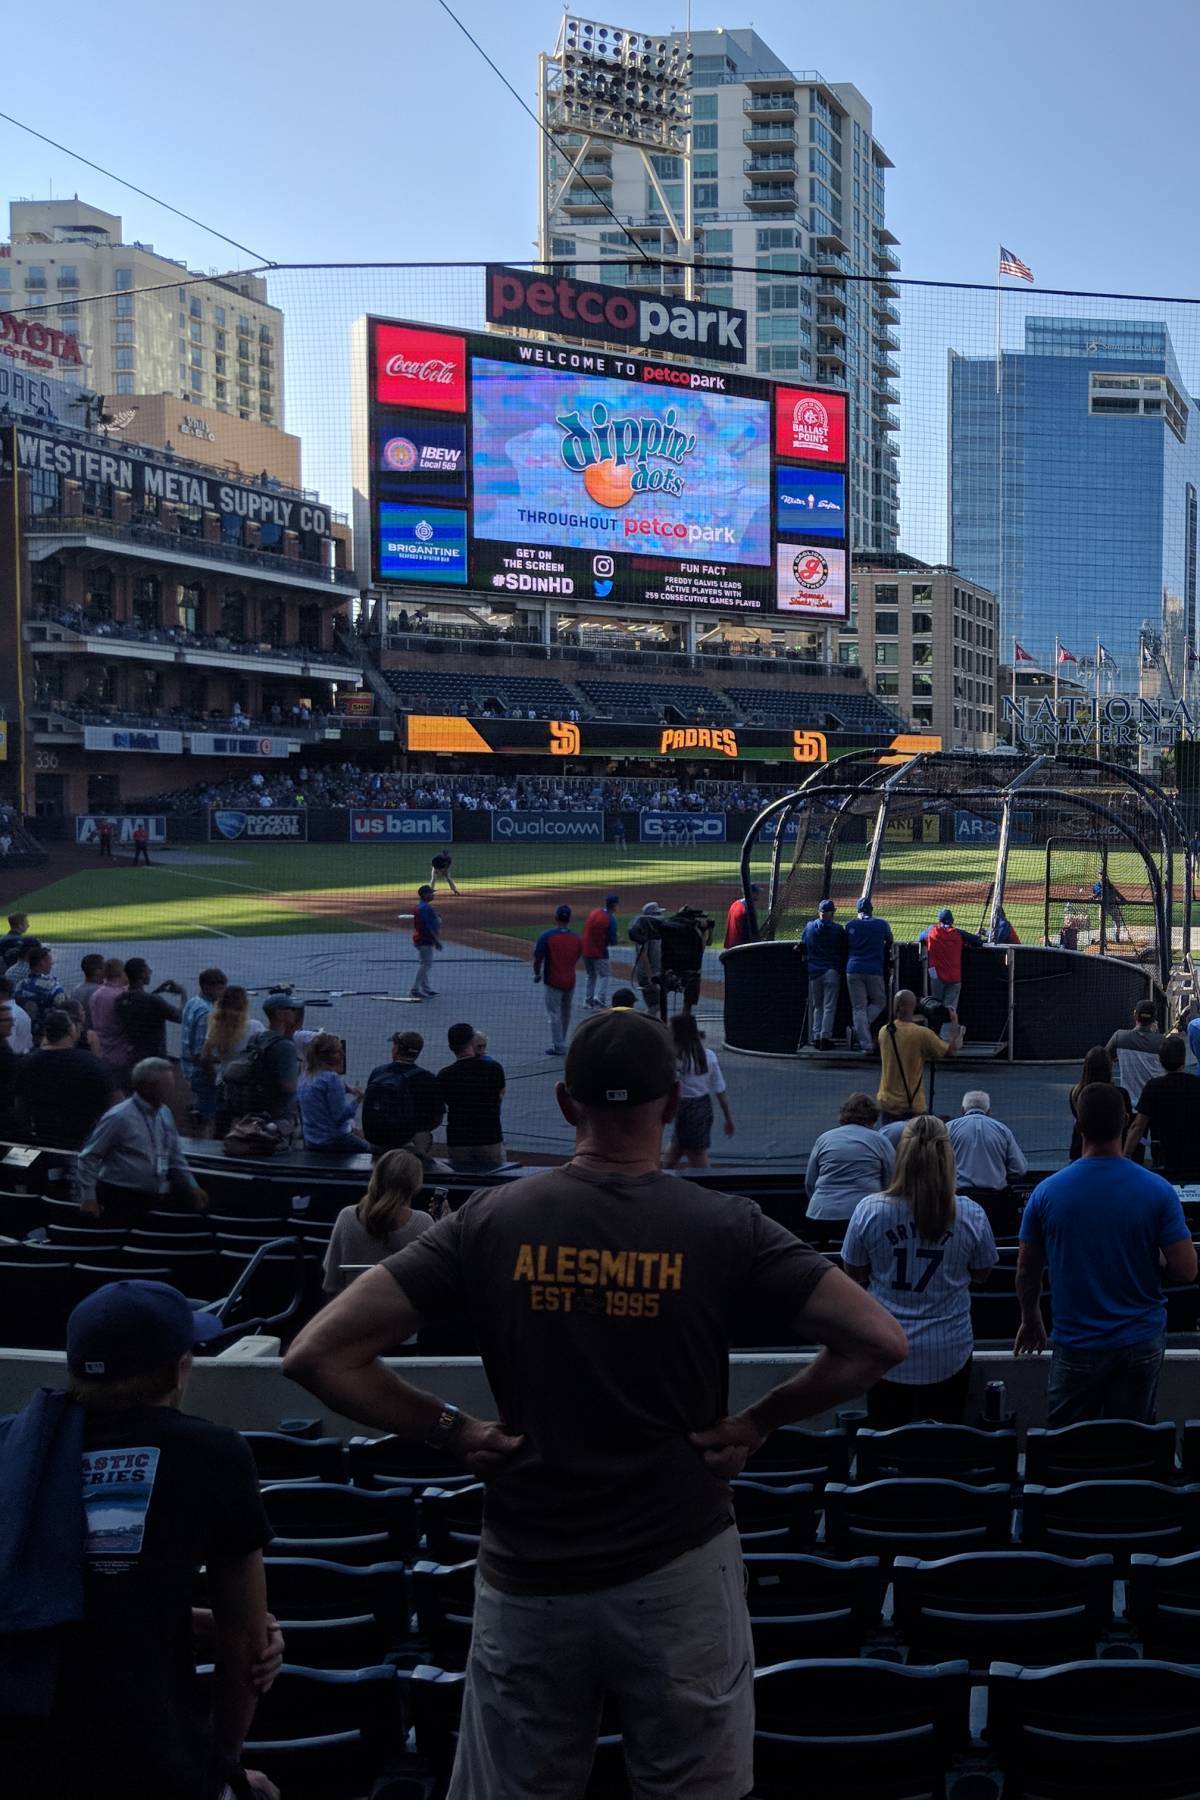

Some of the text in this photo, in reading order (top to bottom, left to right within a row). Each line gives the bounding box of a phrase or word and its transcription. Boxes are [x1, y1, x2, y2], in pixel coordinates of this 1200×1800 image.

[385, 353, 457, 385] Coca-Cola
[519, 346, 605, 371] WELCOME
[615, 361, 636, 376] TO
[792, 423, 829, 436] BALLAST
[798, 433, 824, 443] POINT
[422, 446, 461, 462] IBEW
[420, 459, 457, 471] Local 569
[17, 432, 133, 489] WESTERN
[145, 466, 215, 510] METAL
[219, 486, 293, 527] SUPPLY
[300, 507, 330, 536] CO.
[630, 463, 685, 498] dots
[517, 509, 618, 532] THROUGHOUT
[388, 543, 460, 557] BRIGANTINE
[516, 548, 552, 560] GET ON
[503, 558, 565, 573] THE SCREEN
[680, 563, 727, 576] FUN FACT
[664, 576, 742, 589] FREDDY GALVIS LEADS
[665, 585, 690, 593] ACTIVE
[691, 588, 723, 596] PLAYERS
[660, 592, 708, 604] CONSECUTIVE
[709, 597, 734, 605] GAMES
[735, 599, 761, 608] PLAYED
[661, 728, 738, 757] PADRES
[35, 751, 58, 768] 336
[248, 815, 299, 825] ROCKET
[497, 817, 600, 836] Qualcomm
[644, 818, 723, 835] GCO
[247, 825, 300, 835] LEAGUE
[885, 1221, 954, 1246] BRYT
[513, 1244, 684, 1290] ALESMITH
[891, 1248, 945, 1292] 17
[531, 1284, 660, 1318] EST 1995
